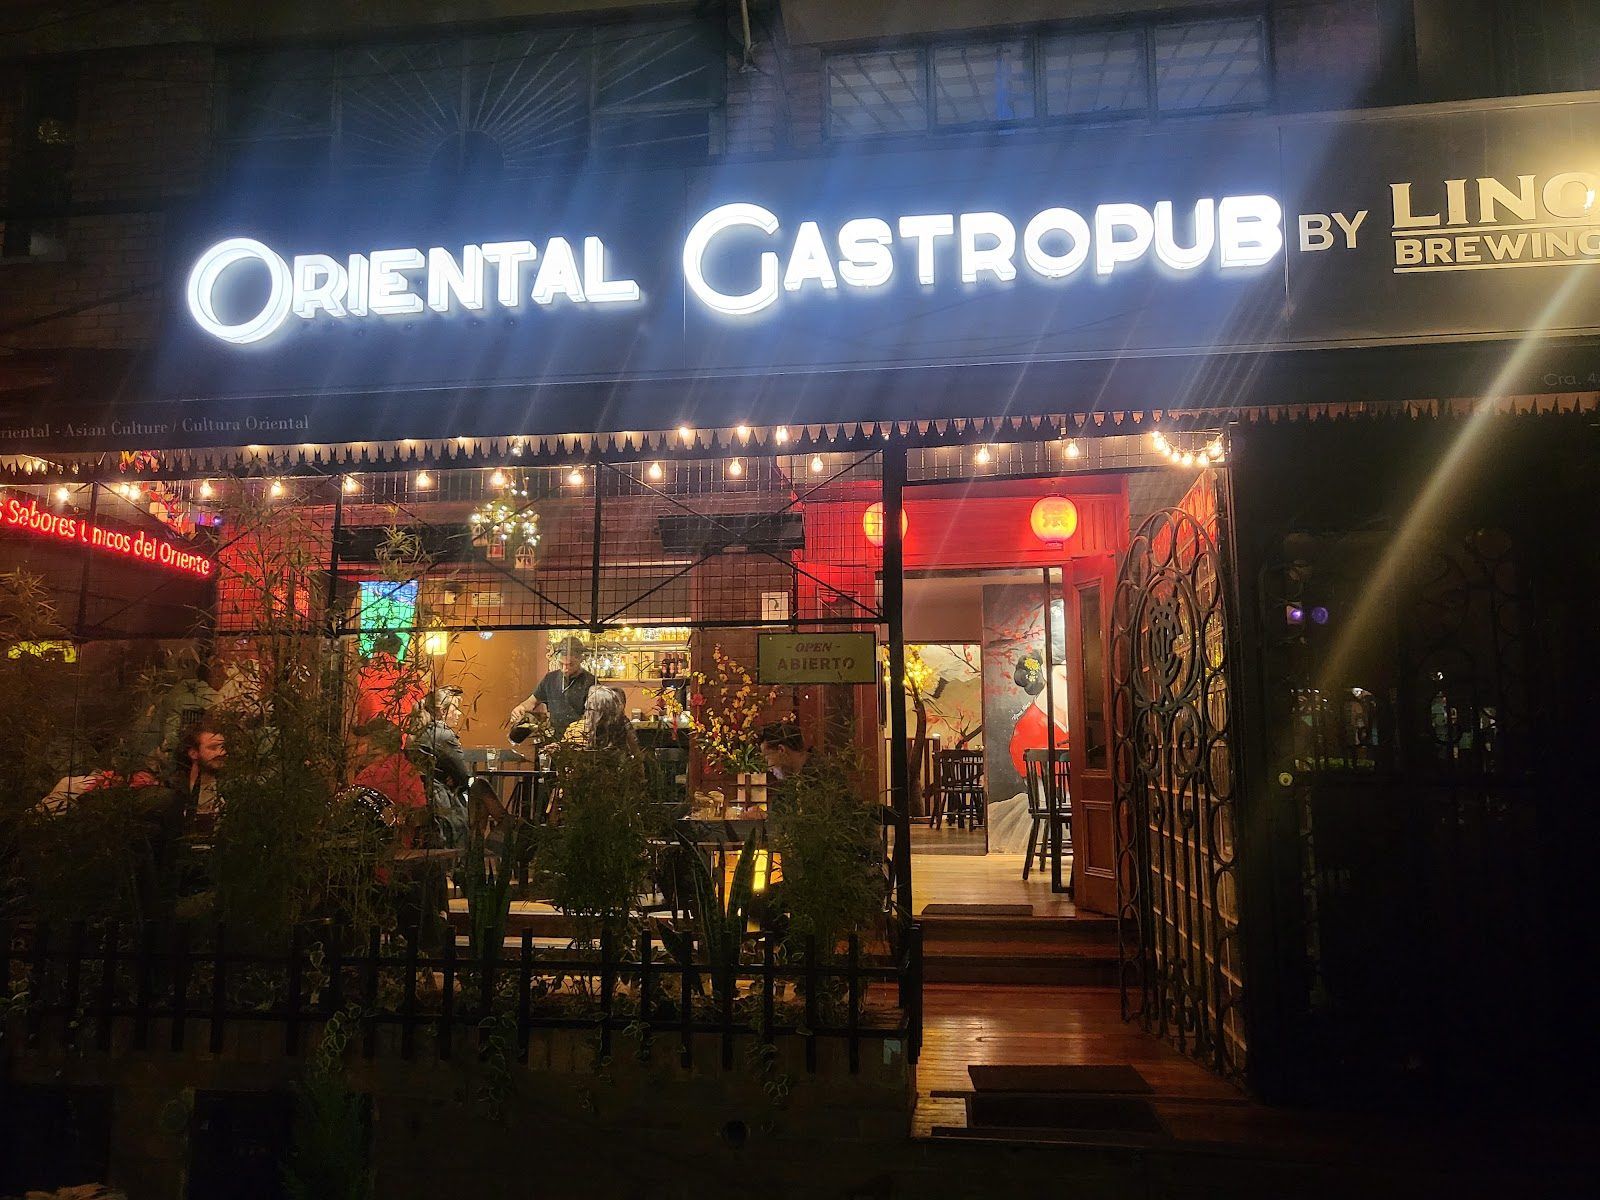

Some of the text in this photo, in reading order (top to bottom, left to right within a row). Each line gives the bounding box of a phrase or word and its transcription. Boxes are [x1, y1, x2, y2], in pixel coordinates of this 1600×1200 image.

[187, 194, 1369, 344] ORIENTAL GASTROPUB BY
[64, 423, 107, 437] Asian
[111, 420, 169, 435] Culture
[182, 416, 241, 432] Cultura
[245, 414, 309, 430] Oriental
[8, 500, 77, 538] Sabores
[133, 530, 157, 560] del
[160, 542, 210, 575] Oriente
[795, 642, 833, 654] OPEN
[777, 656, 856, 672] ABIERTO
